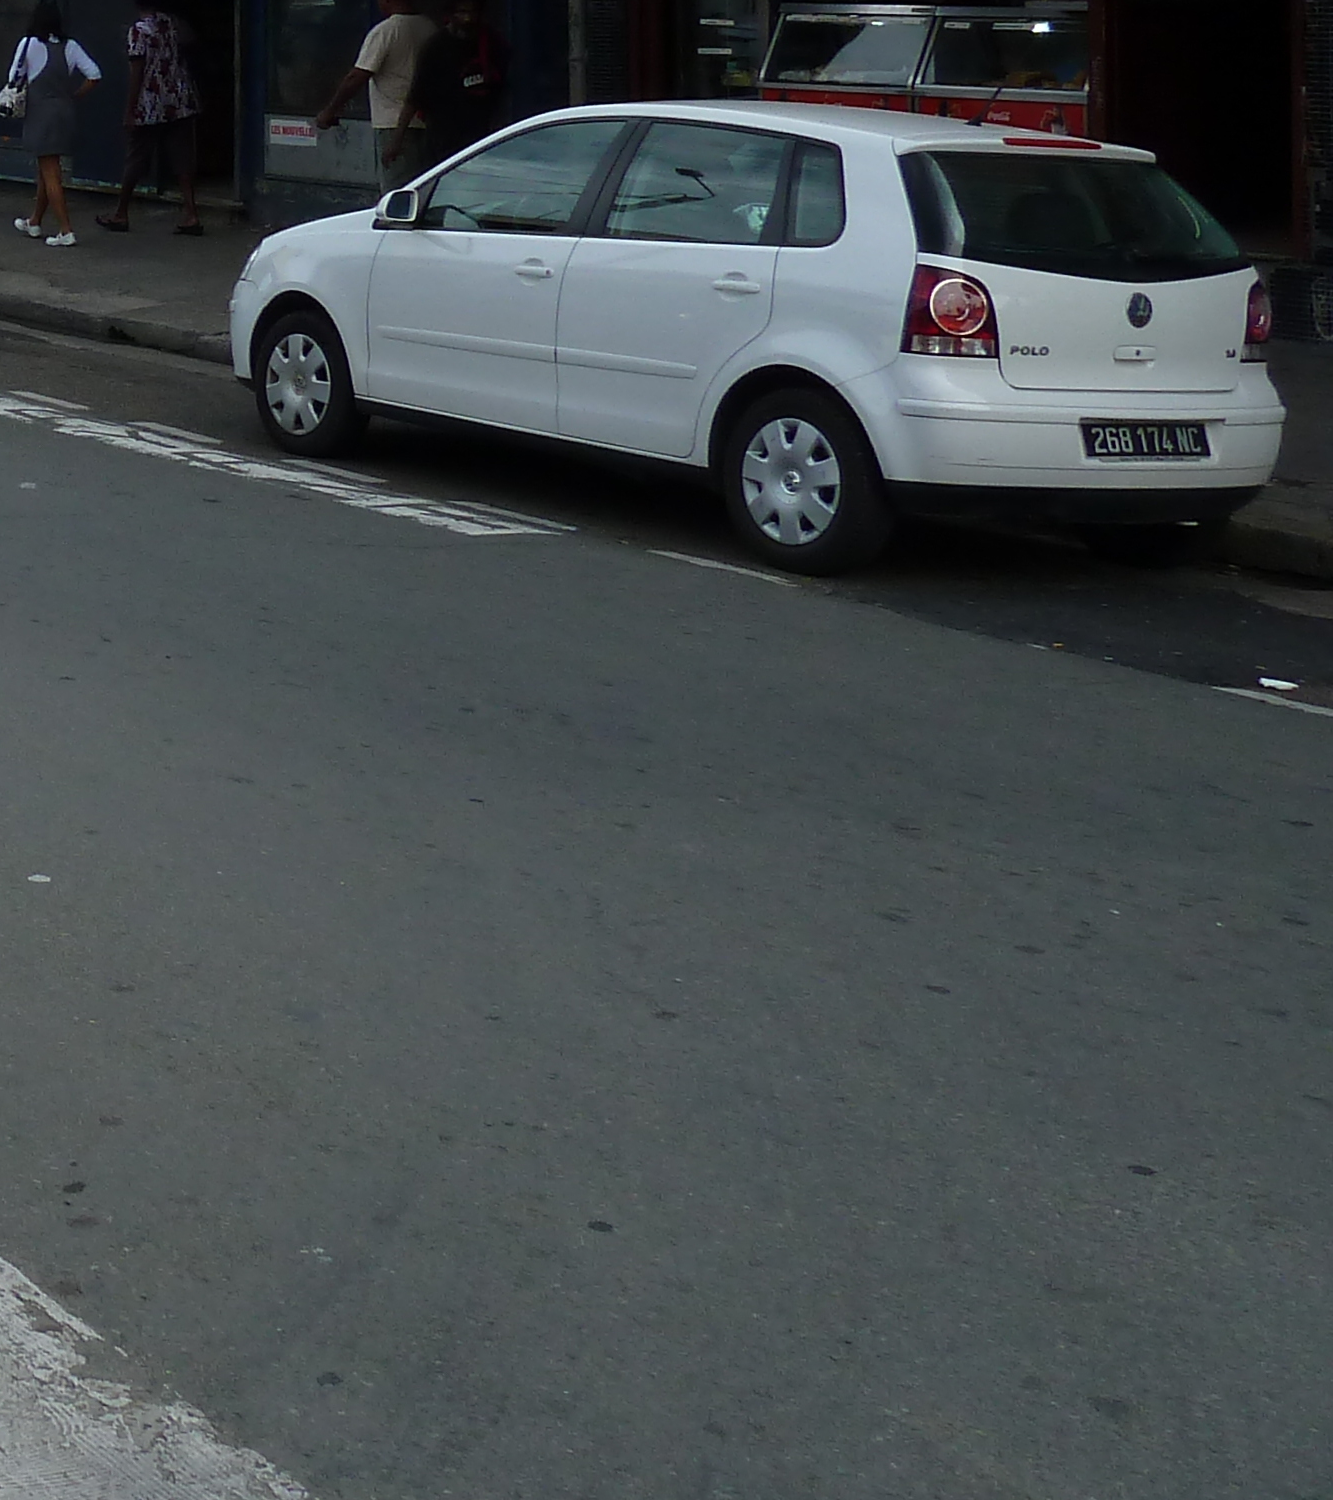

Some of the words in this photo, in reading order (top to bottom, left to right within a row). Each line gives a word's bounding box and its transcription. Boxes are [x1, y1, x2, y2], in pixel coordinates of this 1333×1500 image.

[1009, 345, 1050, 356] POLO
[1091, 427, 1134, 453] 268
[1137, 427, 1174, 453] 174
[1175, 427, 1202, 453] NC
